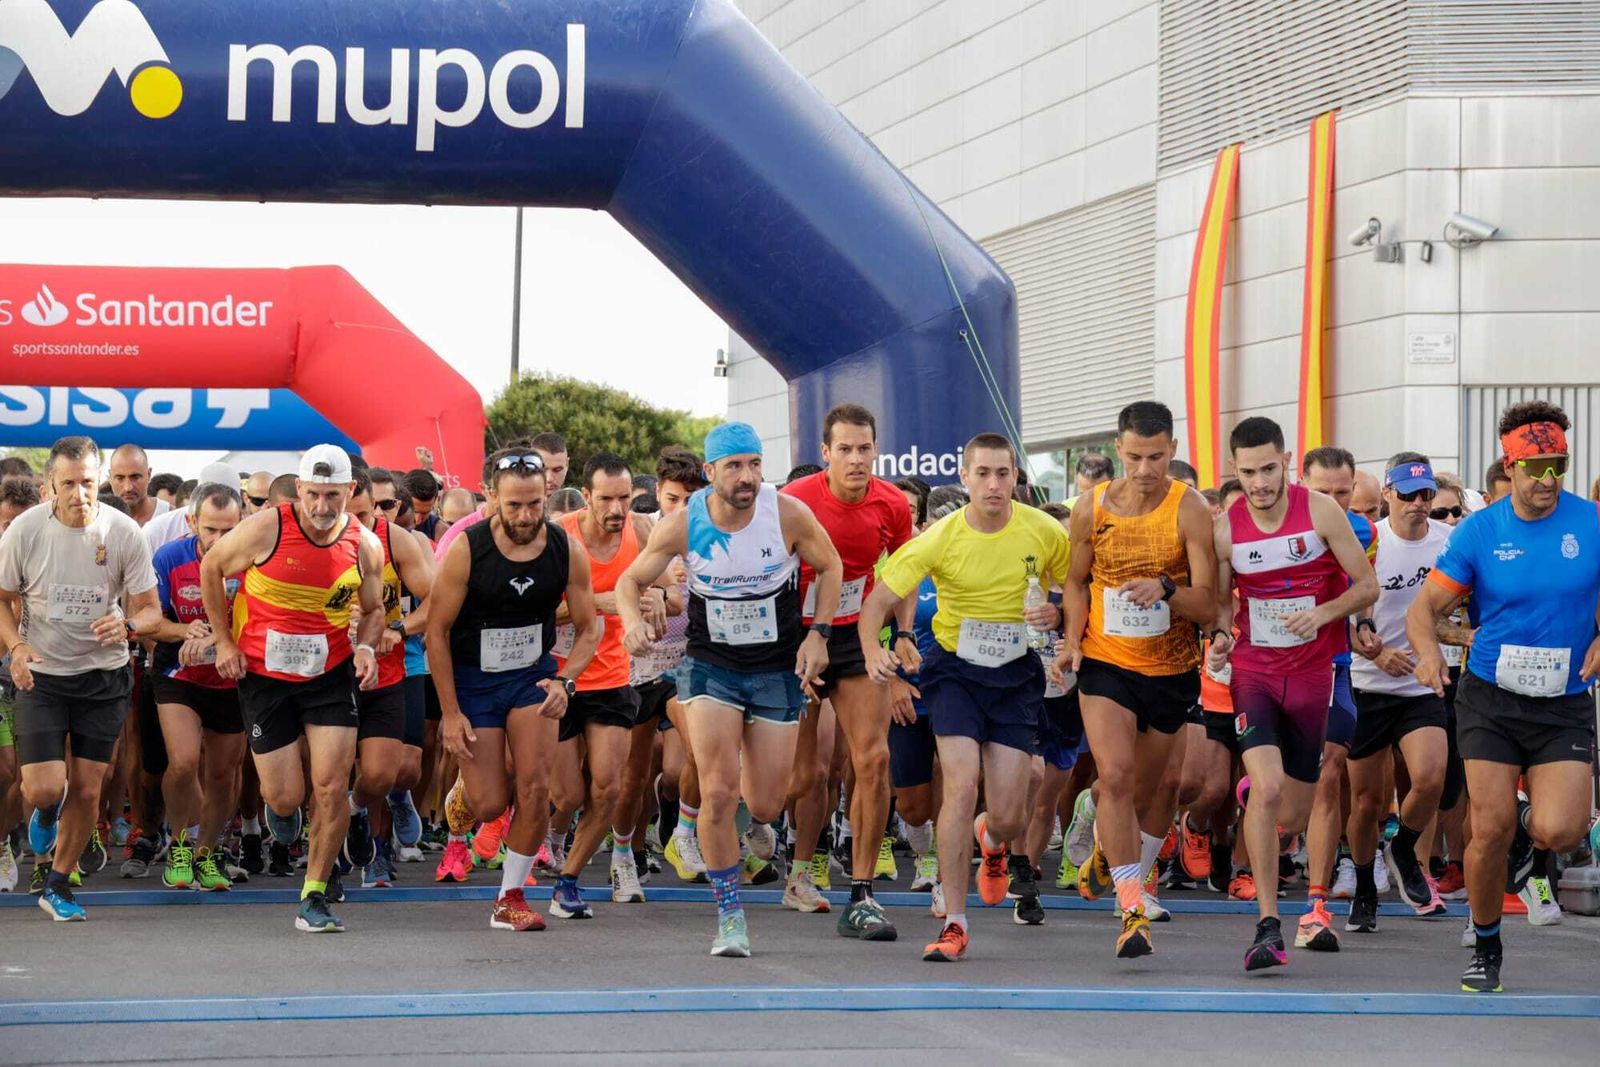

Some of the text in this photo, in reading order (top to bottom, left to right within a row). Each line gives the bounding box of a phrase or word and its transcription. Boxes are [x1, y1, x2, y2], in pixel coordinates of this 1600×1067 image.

[228, 23, 585, 151] mupol
[75, 293, 273, 327] Santander
[12, 342, 140, 357] sportssantander.es
[713, 572, 775, 584] TrailRunner
[65, 605, 91, 616] 572
[1122, 616, 1150, 627] 632
[732, 623, 751, 634] 85
[500, 650, 524, 662] 242
[978, 644, 1006, 658] 602
[1517, 674, 1546, 687] 621
